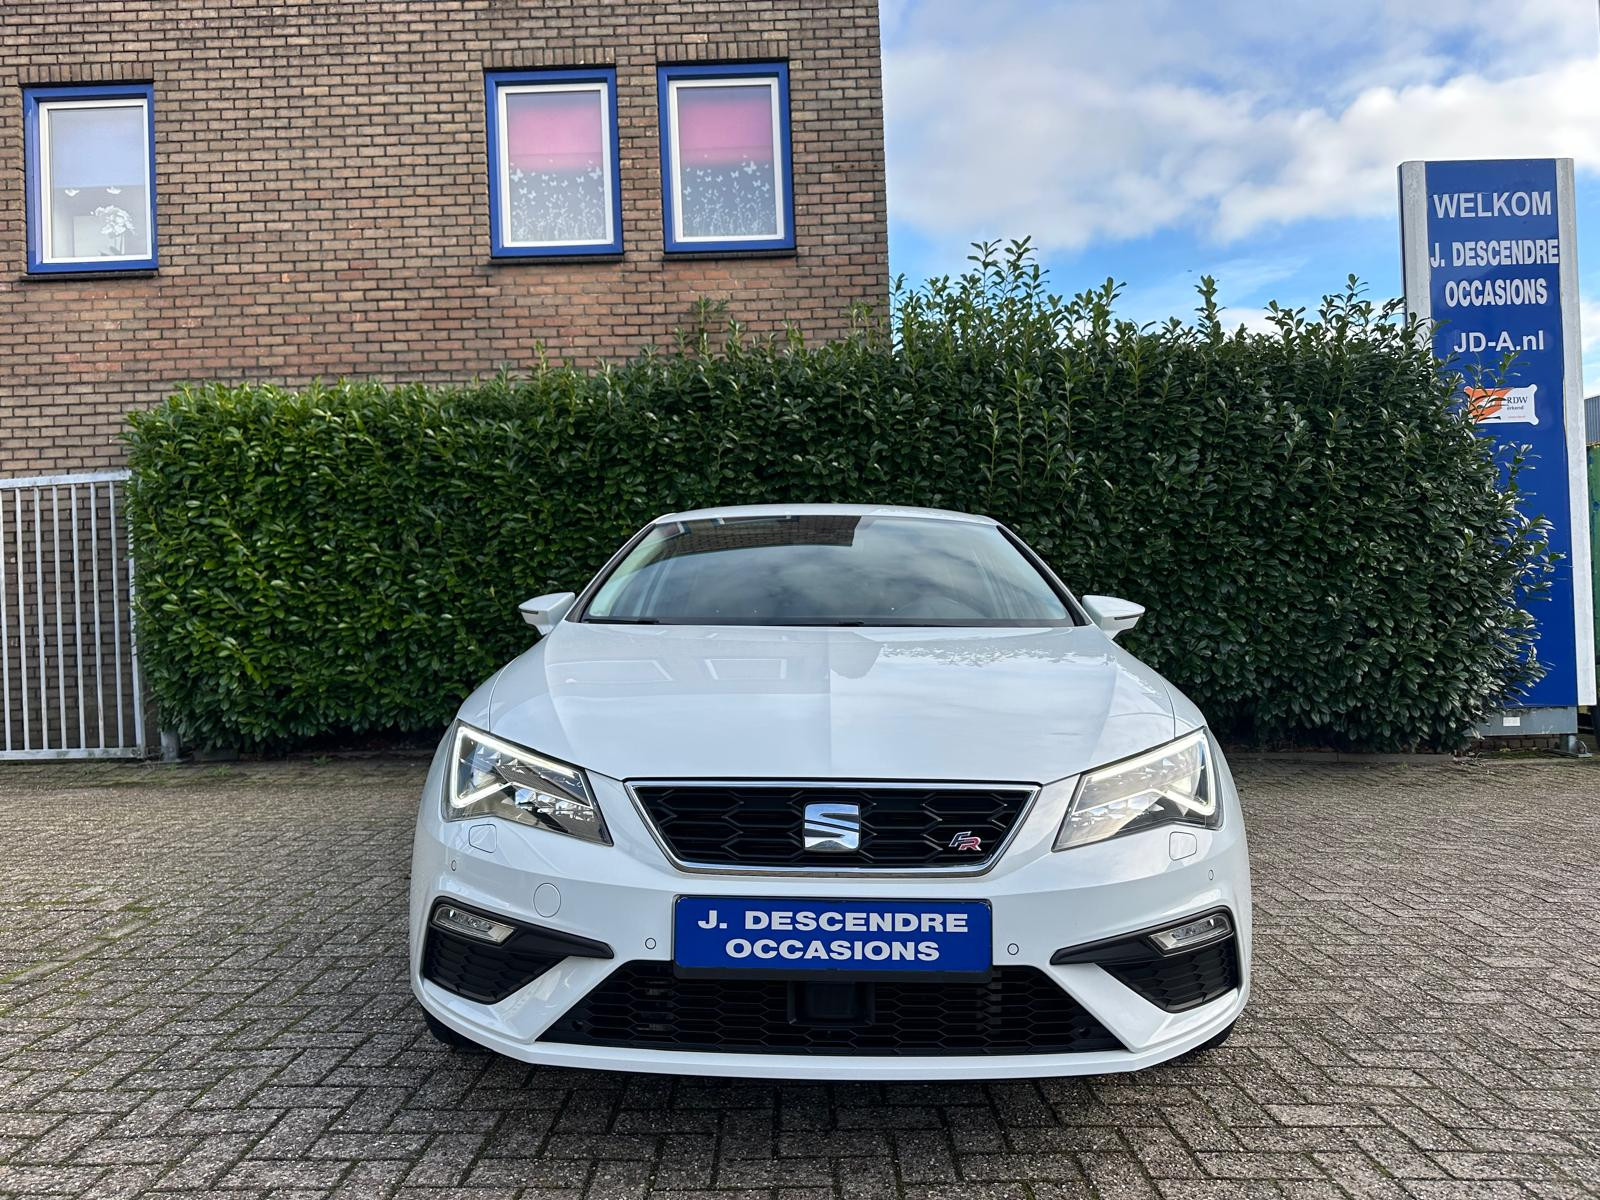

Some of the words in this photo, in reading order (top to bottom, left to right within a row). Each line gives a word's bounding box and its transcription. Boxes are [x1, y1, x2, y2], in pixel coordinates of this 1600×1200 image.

[1433, 191, 1552, 218] WELKOM
[1430, 242, 1445, 268] J.
[1452, 239, 1560, 267] DESCENDRE
[1445, 278, 1548, 307] OCCASIONS
[1454, 330, 1544, 353] JD-A.nl
[1507, 396, 1528, 404] RDW
[697, 910, 728, 930] J.
[744, 910, 969, 933] DESCENDRE
[725, 938, 940, 962] OCCASIONS
